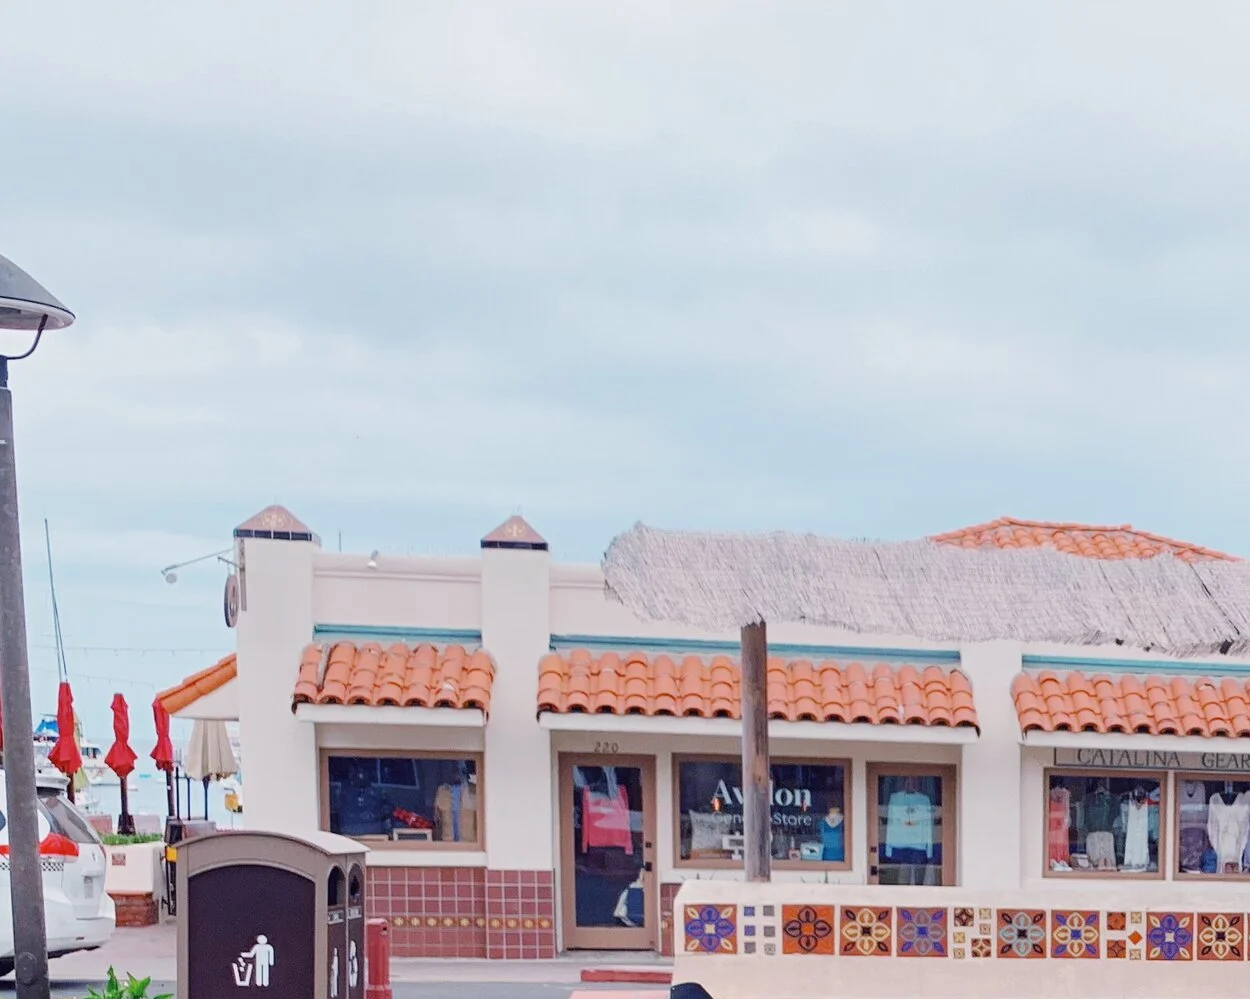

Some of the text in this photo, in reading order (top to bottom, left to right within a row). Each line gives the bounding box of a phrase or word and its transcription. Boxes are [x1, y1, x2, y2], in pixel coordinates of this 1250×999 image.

[594, 741, 619, 754] 220
[1077, 748, 1182, 767] CATALINA
[711, 778, 812, 807] Avlon
[773, 811, 812, 826] Store
